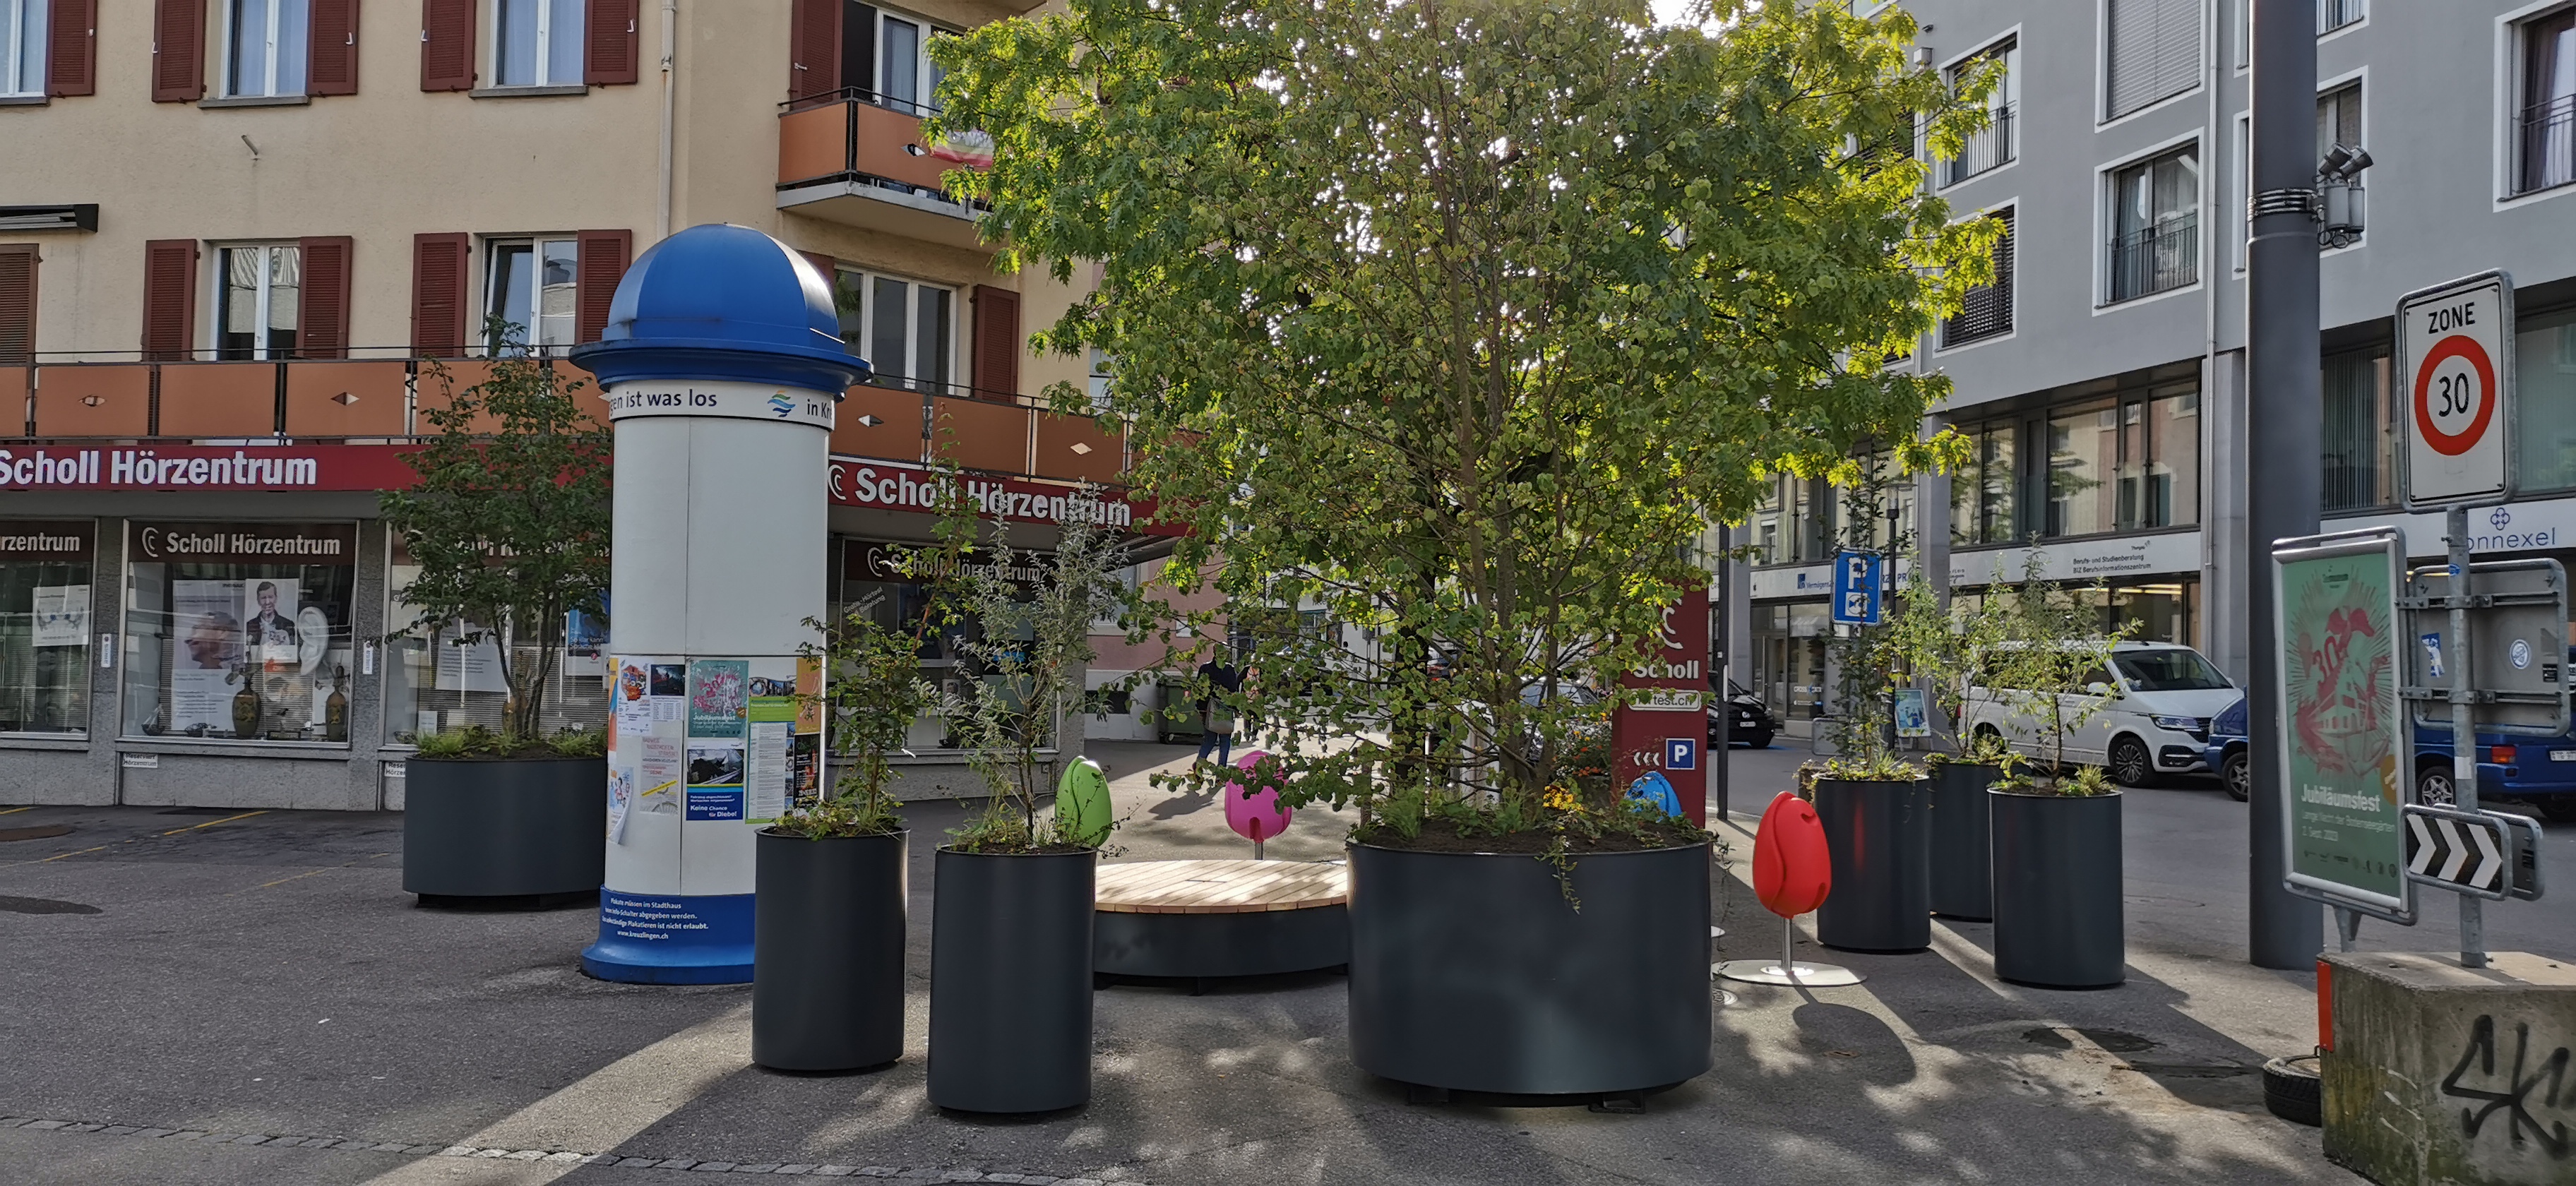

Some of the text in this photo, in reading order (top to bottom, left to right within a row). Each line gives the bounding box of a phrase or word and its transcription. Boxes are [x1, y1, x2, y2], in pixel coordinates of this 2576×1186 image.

[2428, 302, 2476, 335] ZONE
[626, 390, 642, 408] ist
[647, 393, 682, 407] was
[688, 388, 717, 407] los
[2438, 373, 2469, 417] 30
[806, 398, 818, 417] in
[110, 450, 317, 485] Hörzentrum
[854, 467, 1131, 527] Scholl Hörzentrum
[166, 532, 341, 555] Scholl Hörzentrum
[2092, 556, 2101, 564] und
[1848, 557, 1867, 589] P
[1674, 744, 1688, 762] P
[2301, 783, 2380, 813] Jubiläumsfest
[628, 920, 657, 928] Plakatieren
[639, 911, 670, 921] abgegeben
